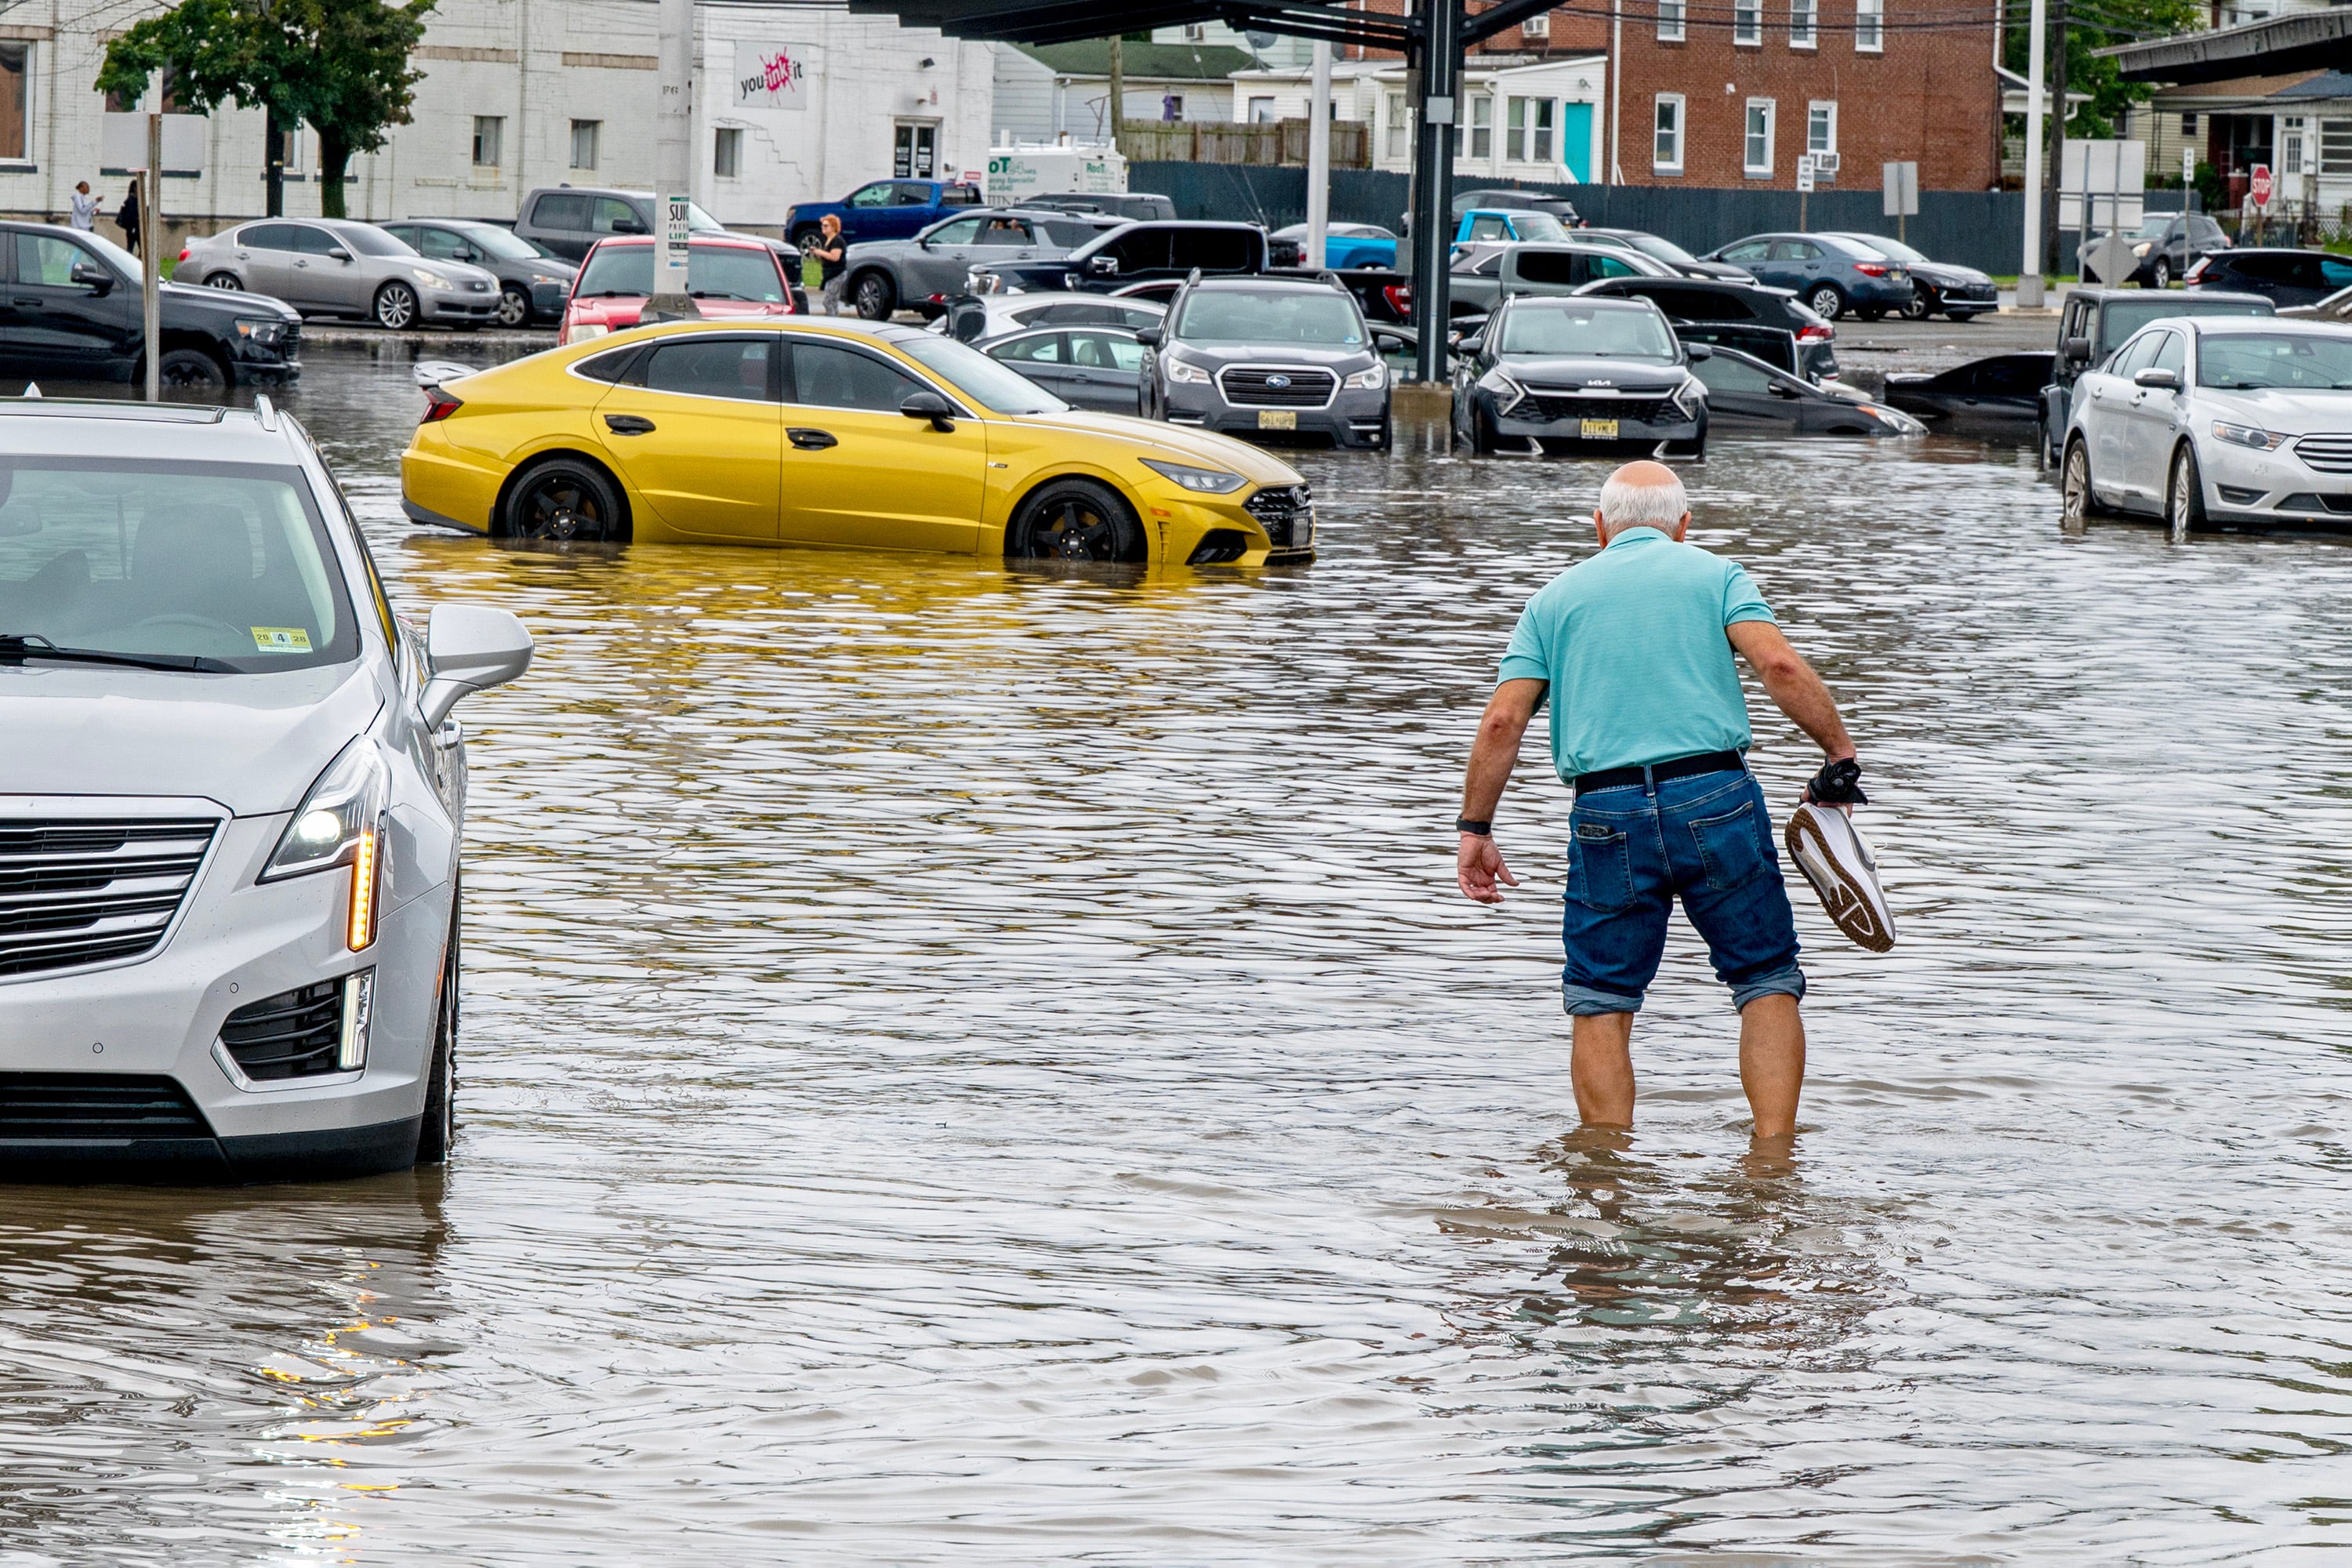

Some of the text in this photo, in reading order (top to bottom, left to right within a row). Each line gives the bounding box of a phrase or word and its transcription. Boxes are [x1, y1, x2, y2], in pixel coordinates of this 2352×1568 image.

[741, 59, 803, 100] you ink it
[2252, 177, 2270, 194] STOP
[256, 633, 269, 641] 20
[277, 633, 285, 643] 4
